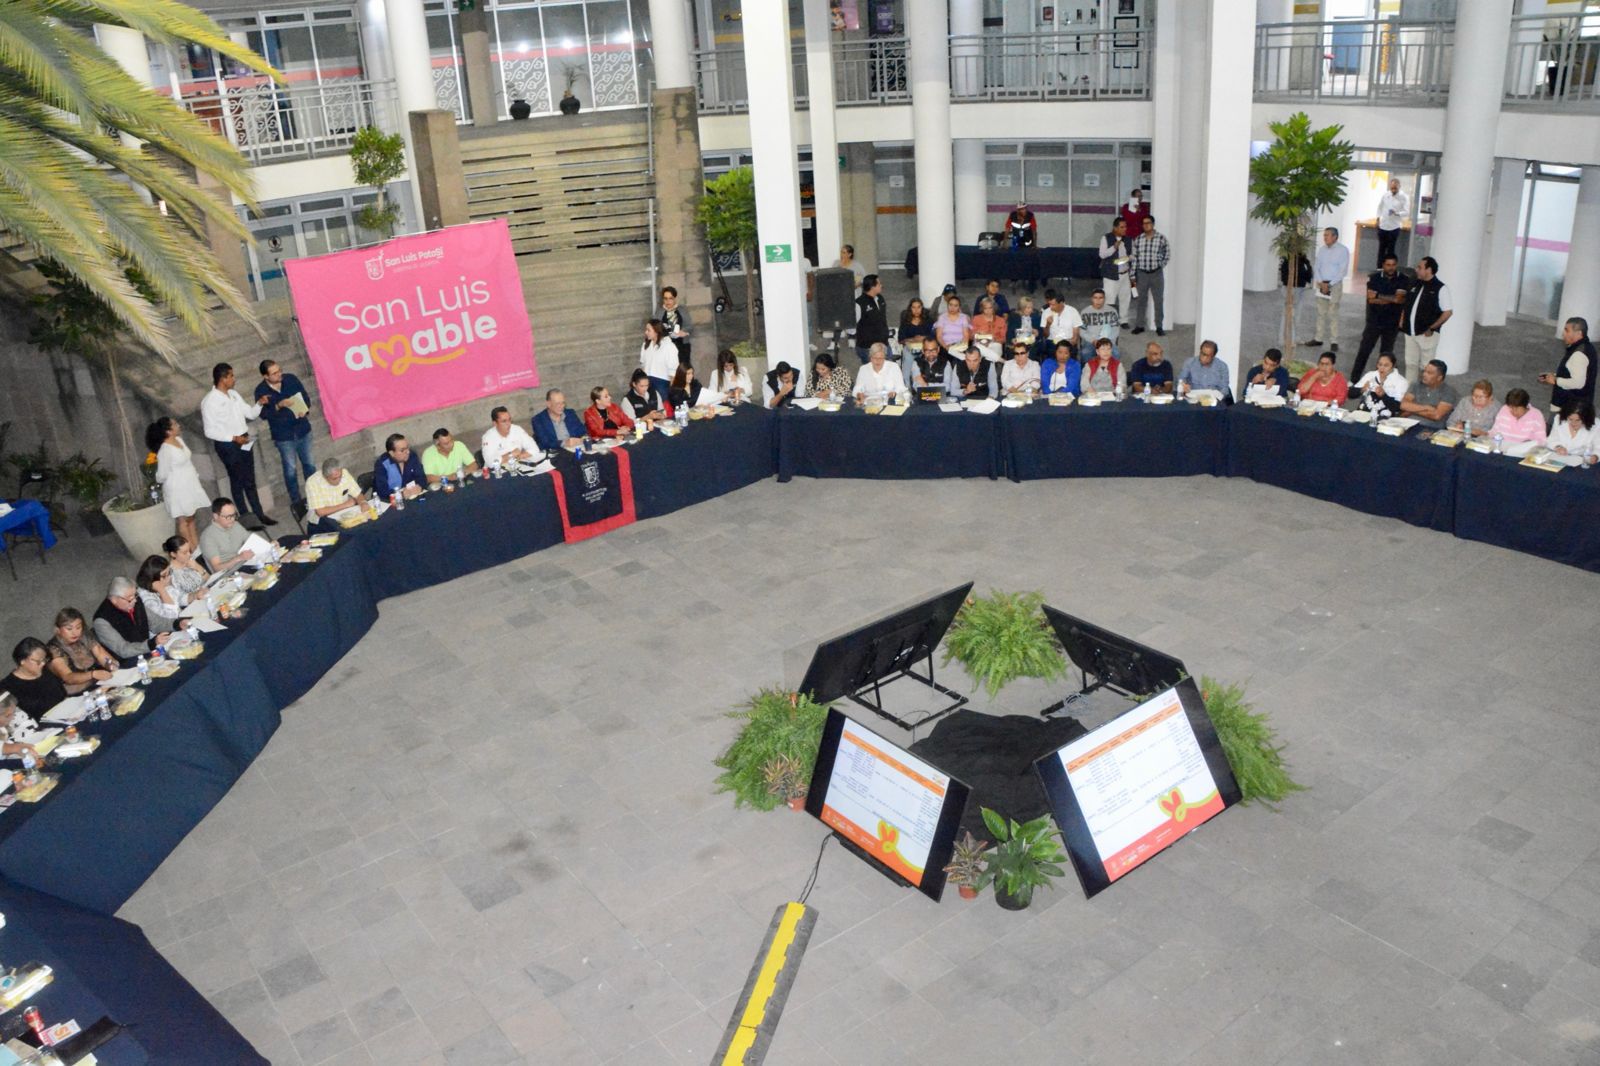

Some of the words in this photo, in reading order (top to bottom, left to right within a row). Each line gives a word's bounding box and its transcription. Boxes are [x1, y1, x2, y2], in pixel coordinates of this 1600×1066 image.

[384, 257, 401, 267] San
[401, 252, 418, 263] Luis
[334, 299, 409, 335] San
[416, 276, 490, 316] Luis
[345, 312, 497, 375] amable
